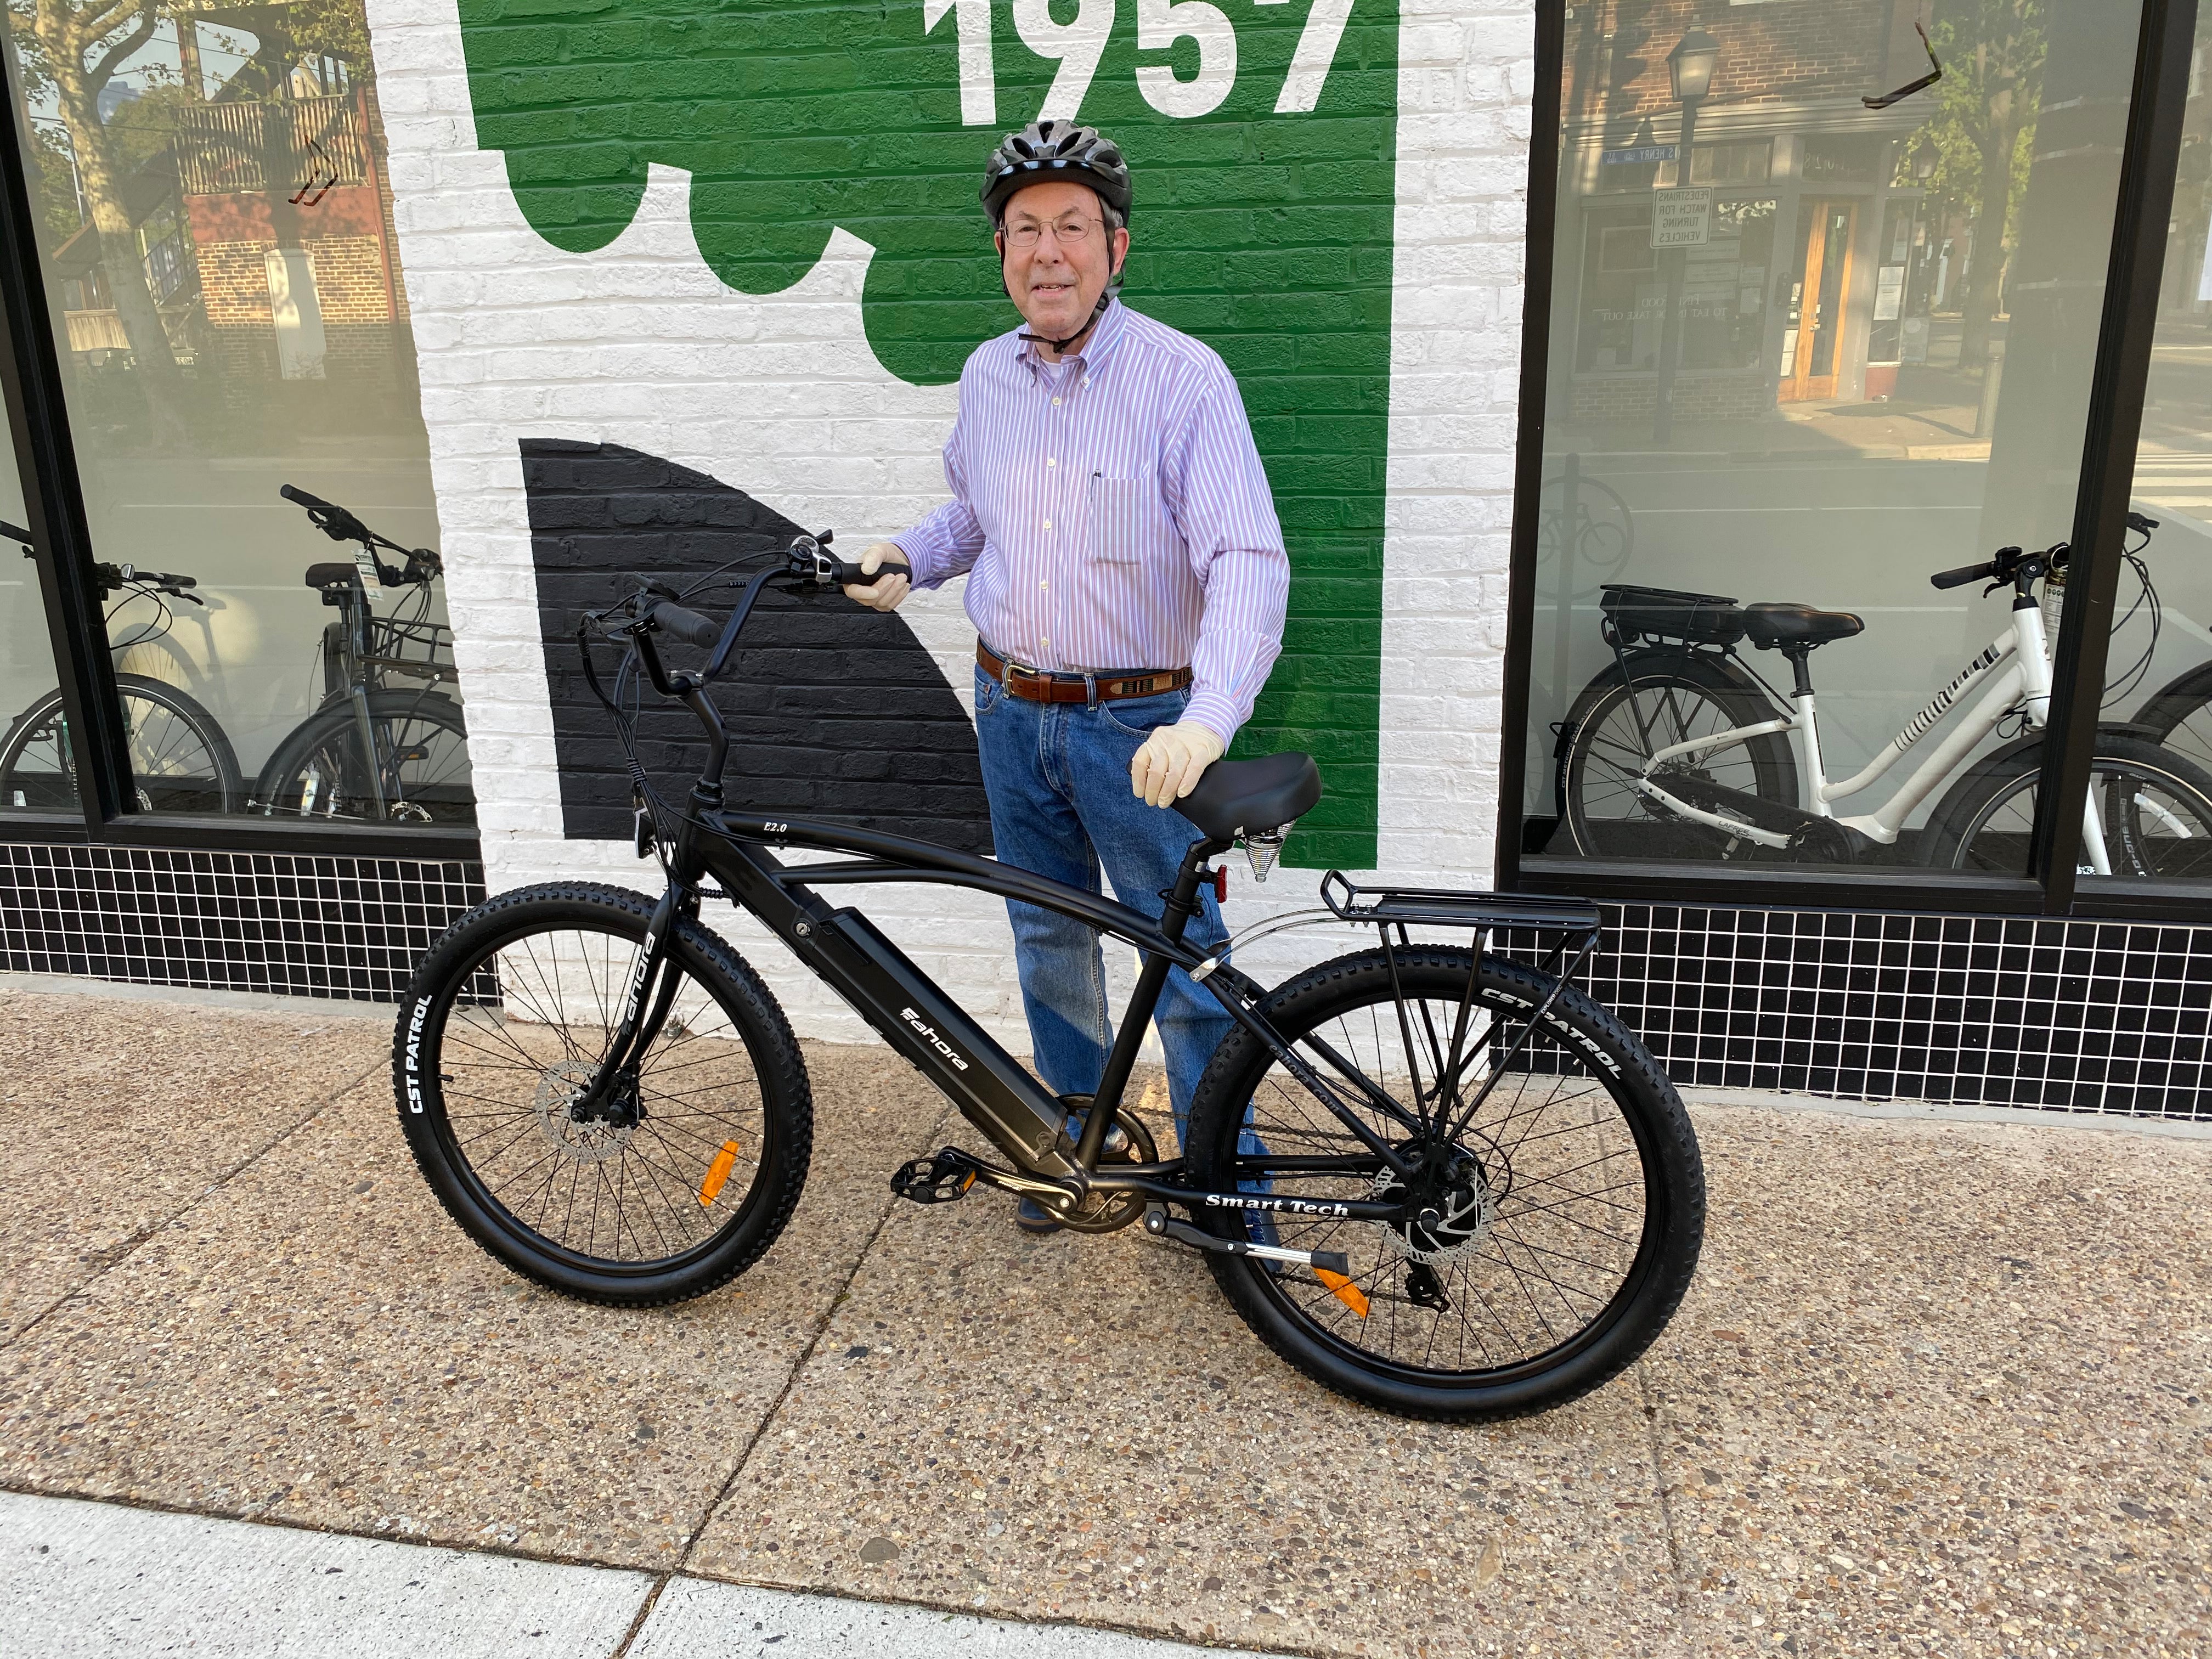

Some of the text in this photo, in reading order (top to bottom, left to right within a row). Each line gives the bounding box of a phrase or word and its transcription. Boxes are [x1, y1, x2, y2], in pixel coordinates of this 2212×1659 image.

[924, 0, 1355, 126] 1957
[763, 822, 787, 833] E2.0
[1718, 821, 1751, 834] LAFREE
[1481, 988, 1534, 1009] CST
[900, 1007, 969, 1071] Eahora
[406, 995, 433, 1114] CST PATROL
[1205, 1194, 1350, 1217] Smart Tech
